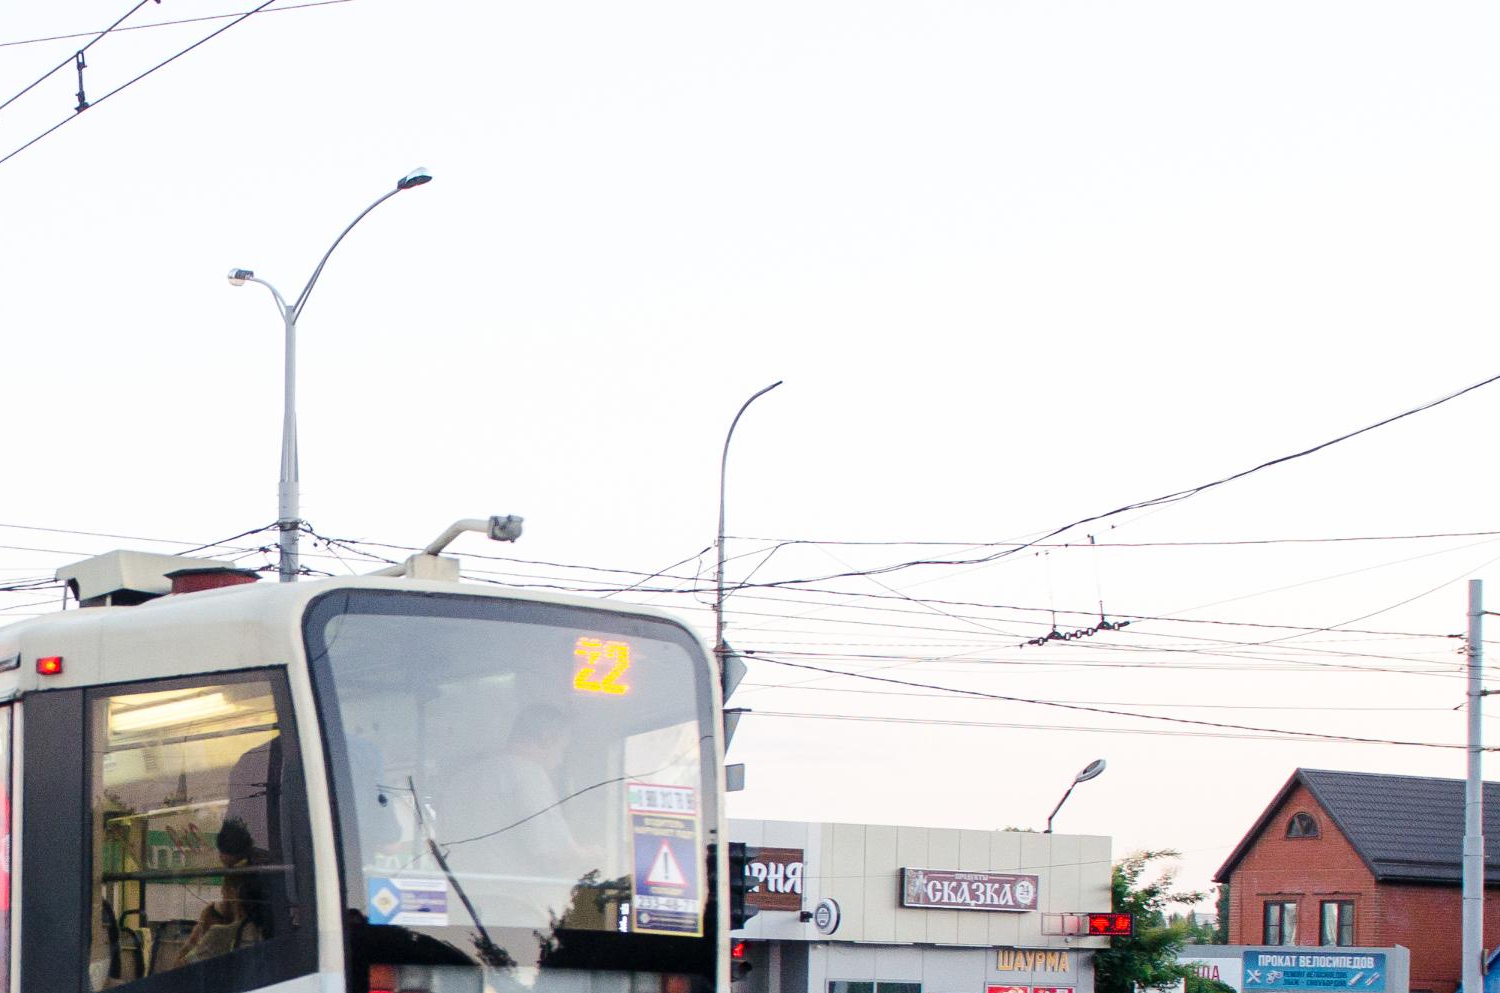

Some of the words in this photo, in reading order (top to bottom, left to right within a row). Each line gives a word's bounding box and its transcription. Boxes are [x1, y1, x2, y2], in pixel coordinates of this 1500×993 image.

[574, 637, 629, 694] 22
[927, 880, 1015, 906] СКАЗКА
[997, 950, 1070, 972] ШАУРМА
[1258, 955, 1297, 967] ПРОКАТ
[1299, 955, 1375, 969] ВЕЛОСИПЕДОВ
